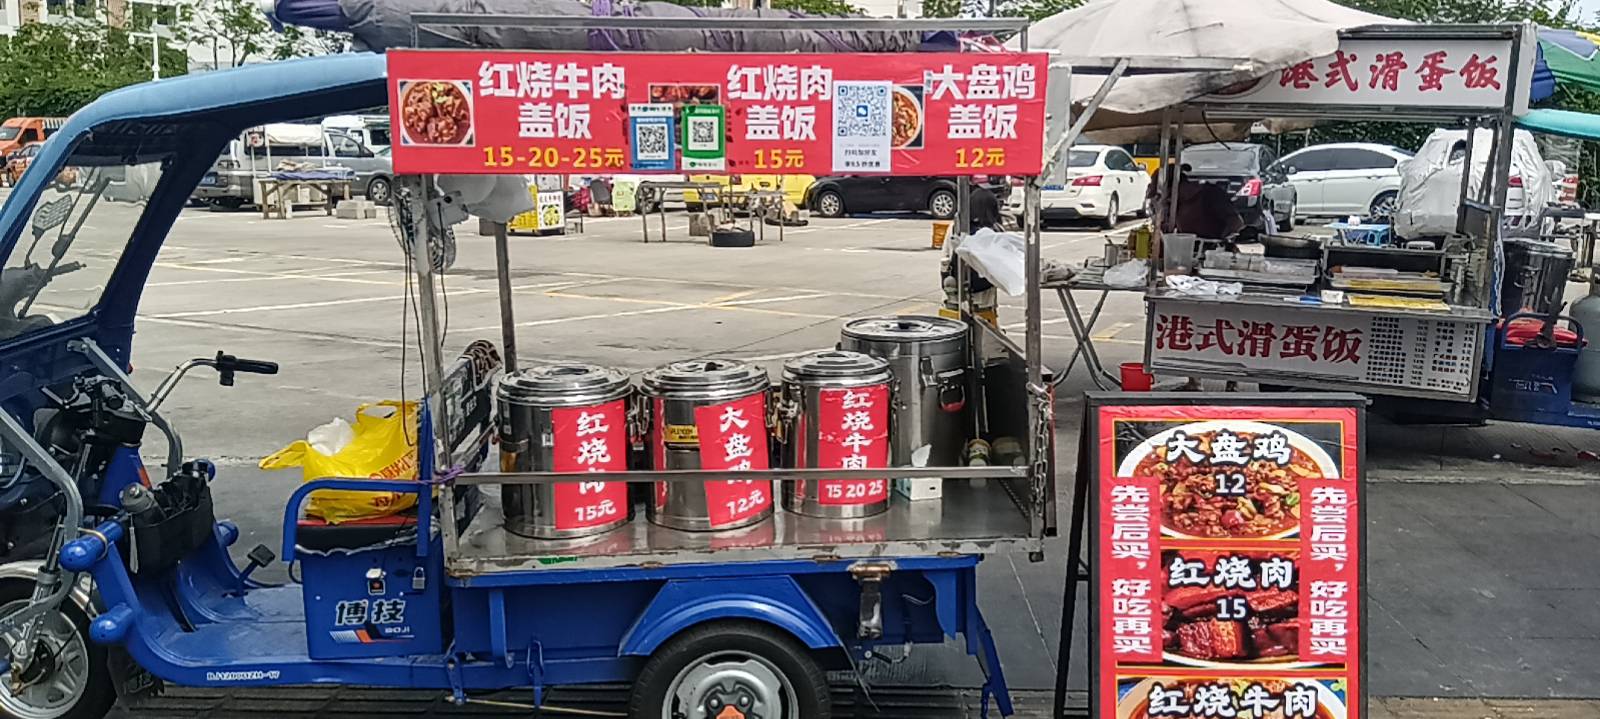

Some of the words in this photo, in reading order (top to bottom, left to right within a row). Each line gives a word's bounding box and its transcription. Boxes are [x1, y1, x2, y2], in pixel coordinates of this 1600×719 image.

[478, 61, 625, 99] 红烧牛肉
[726, 64, 833, 100] 红烧肉
[926, 64, 1036, 100] 大盘鸡
[1279, 51, 1501, 92] 港式滑蛋饭
[518, 103, 593, 140] 盖饭
[745, 104, 816, 141] 盖饭
[946, 103, 1018, 140] 盖饭
[483, 147, 625, 168] 15-20-25元
[753, 148, 805, 169] 15元
[955, 147, 1006, 168] 12元
[1156, 314, 1364, 365] 港式滑蛋饭
[840, 389, 875, 470] 红烧牛肉
[575, 411, 612, 495] 红烧肉
[1167, 430, 1292, 465] 大盘鸡
[825, 484, 842, 498] 15
[845, 484, 866, 498] 20
[868, 480, 884, 496] 25
[1214, 473, 1246, 495] 12
[574, 499, 617, 521] 15元
[726, 489, 764, 518] 12元
[1168, 556, 1294, 589] 红烧肉
[335, 598, 406, 626] 博技
[1215, 598, 1247, 619] 15
[1147, 681, 1318, 717] 红烧牛肉
